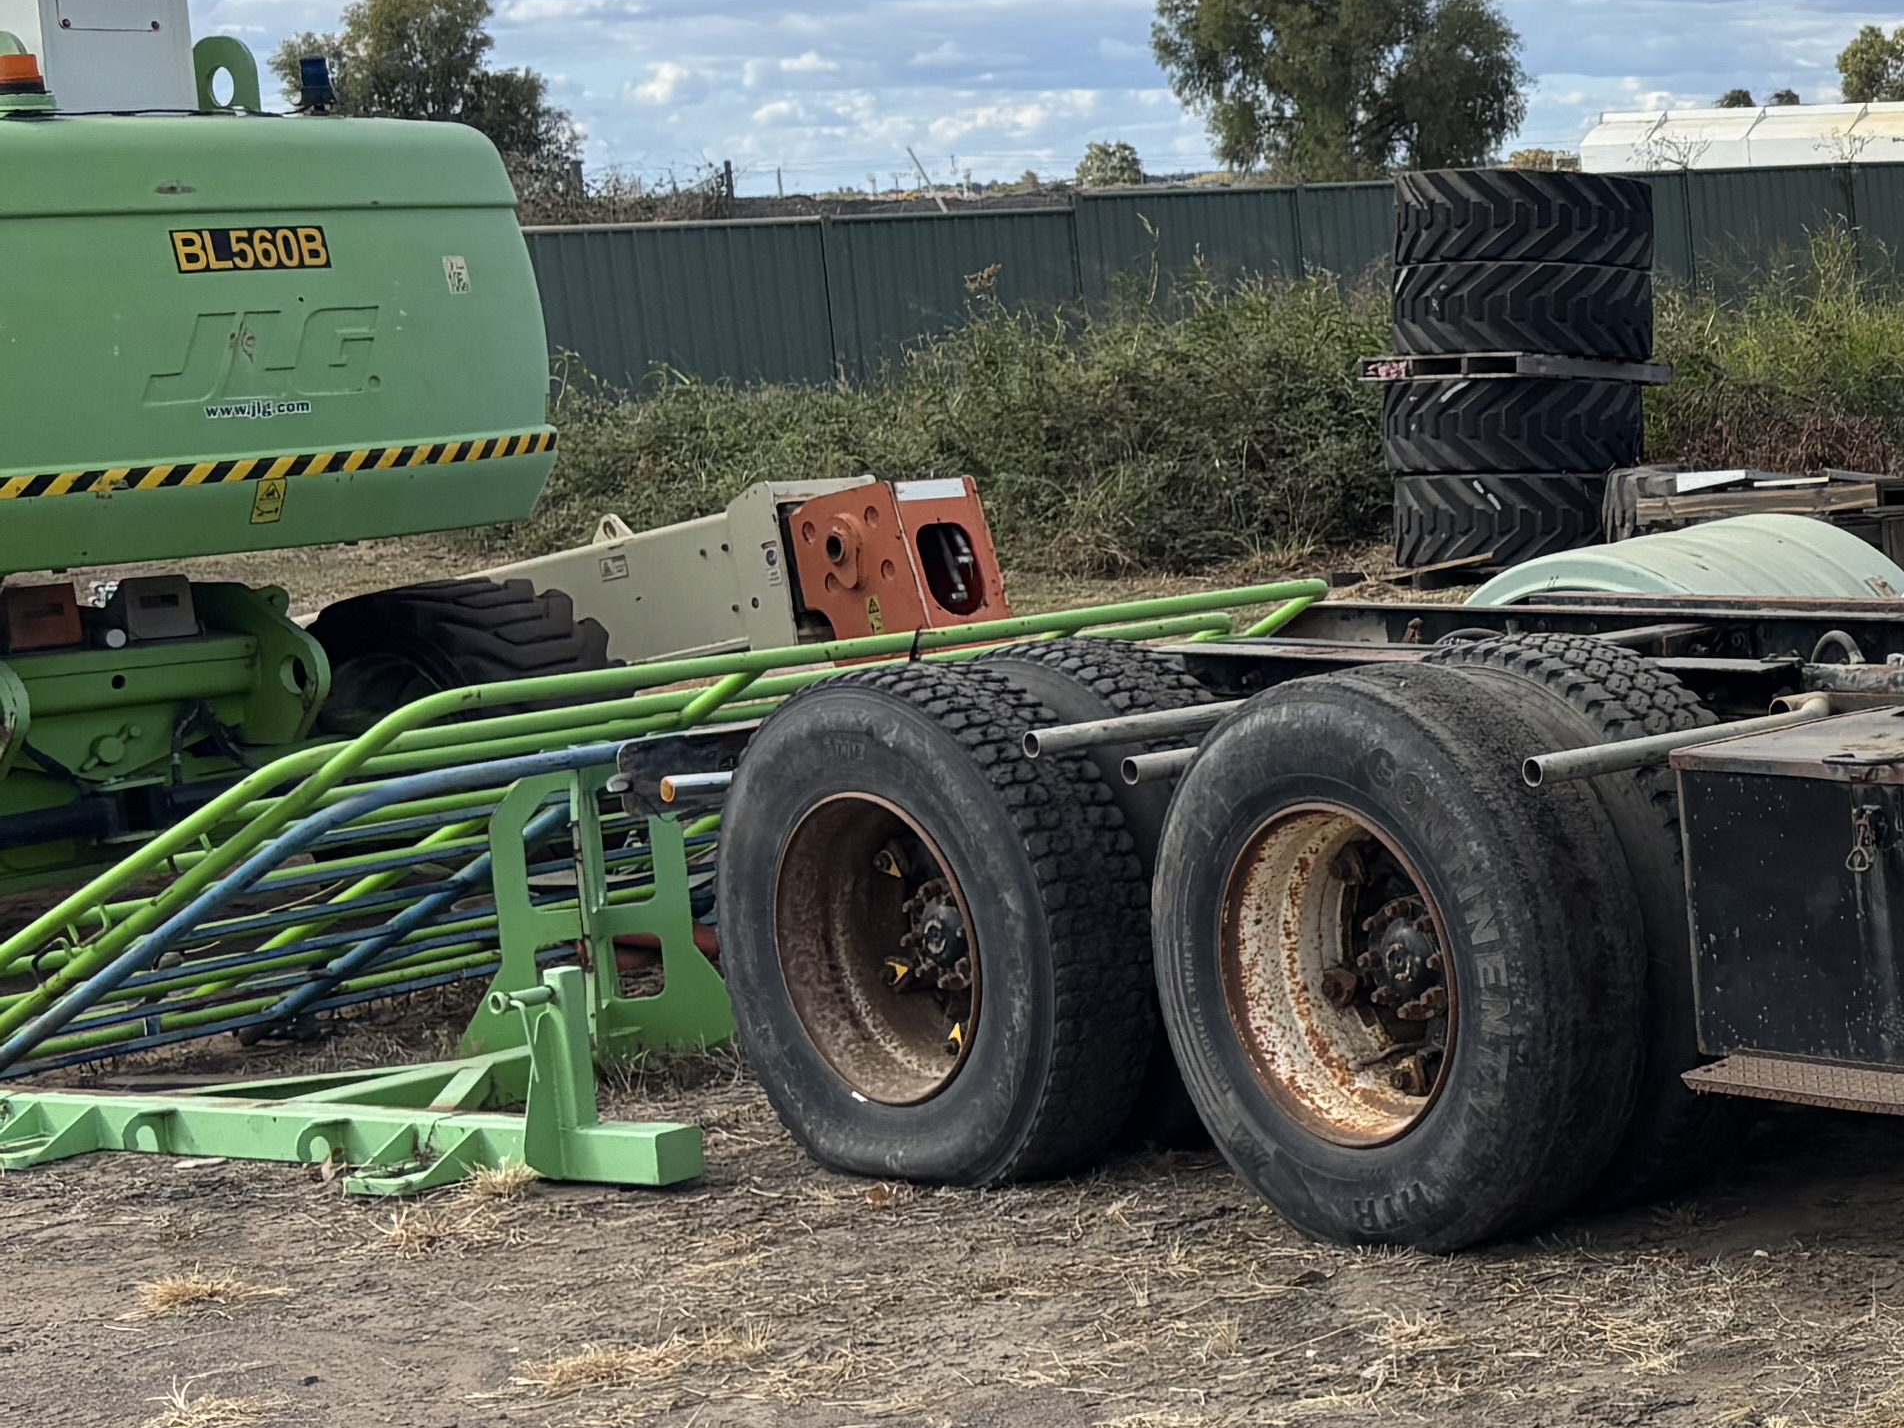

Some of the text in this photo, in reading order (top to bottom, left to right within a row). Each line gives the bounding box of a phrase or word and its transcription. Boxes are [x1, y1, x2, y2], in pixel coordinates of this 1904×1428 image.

[173, 228, 327, 271] BL560B
[143, 305, 380, 407] JLG
[205, 401, 311, 418] www.jlg.com
